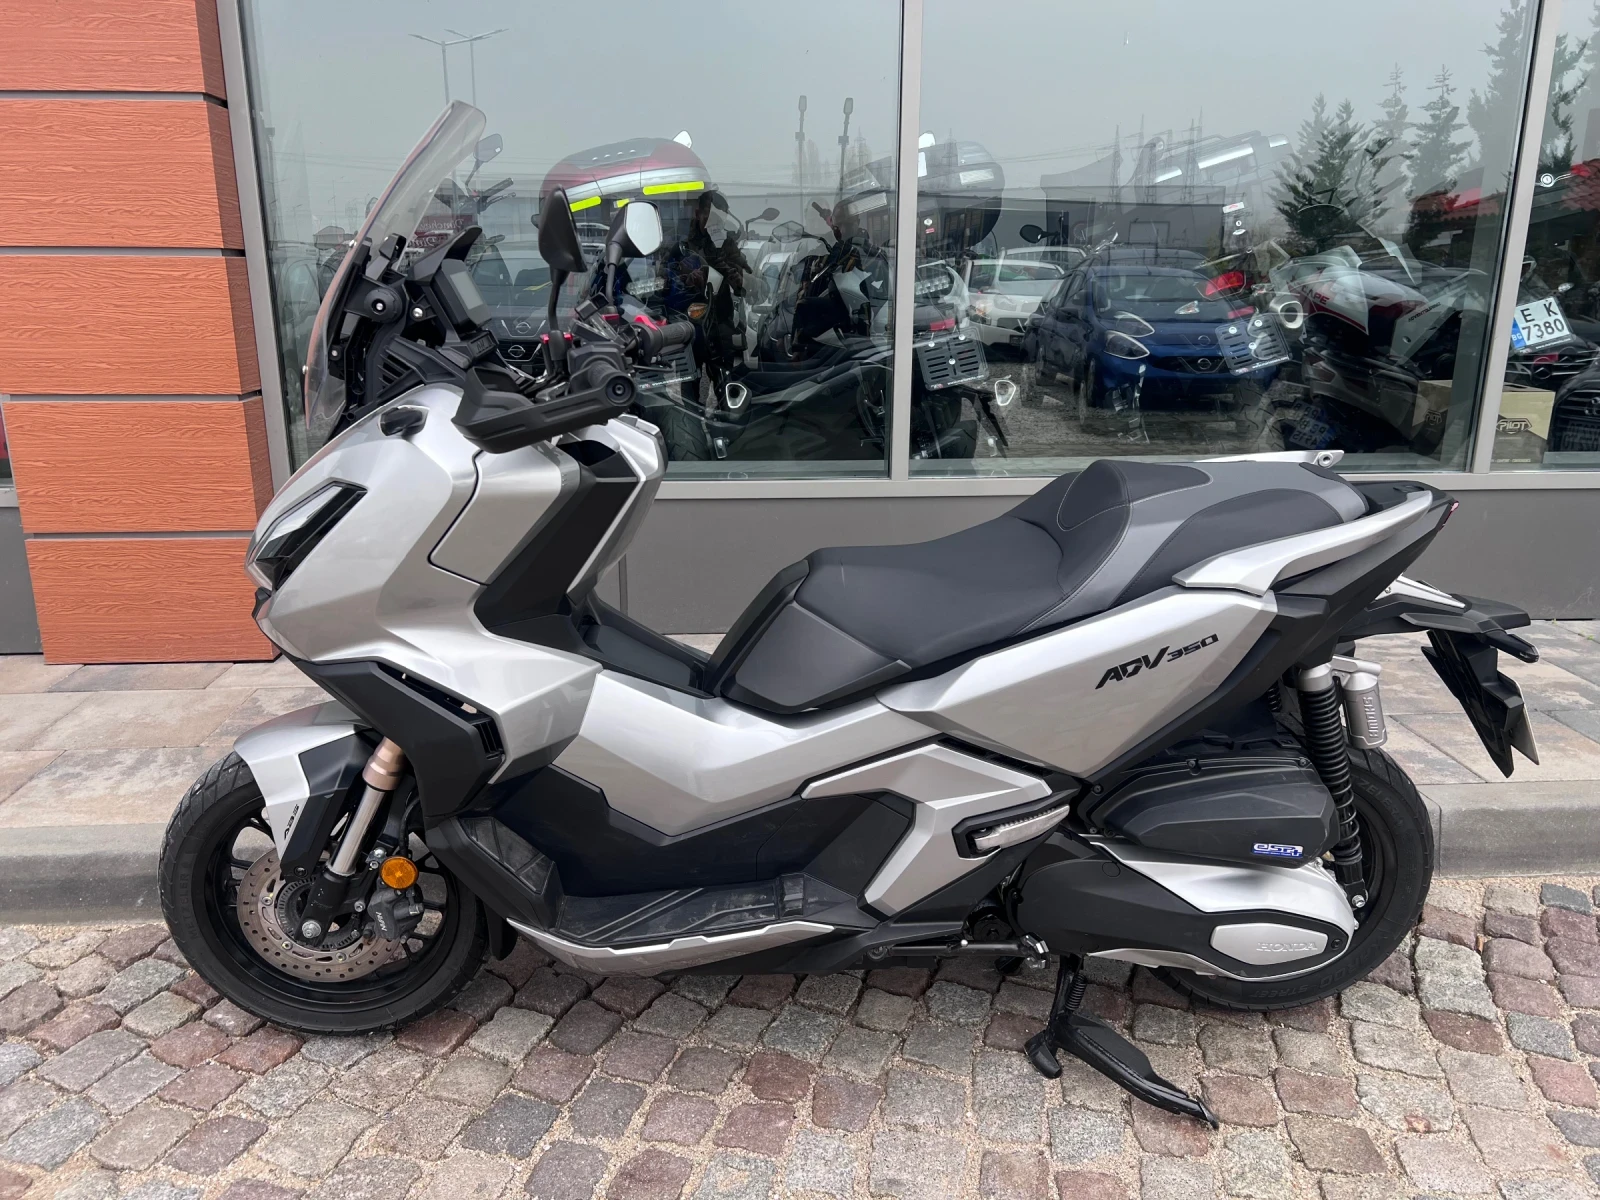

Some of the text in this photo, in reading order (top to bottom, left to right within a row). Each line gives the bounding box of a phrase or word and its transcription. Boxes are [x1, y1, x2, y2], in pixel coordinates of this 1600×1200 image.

[1520, 301, 1558, 323] E K
[1521, 318, 1565, 341] 7380
[1511, 333, 1523, 342] BG
[1499, 420, 1528, 431] PILOT
[1256, 941, 1318, 952] HONDA
